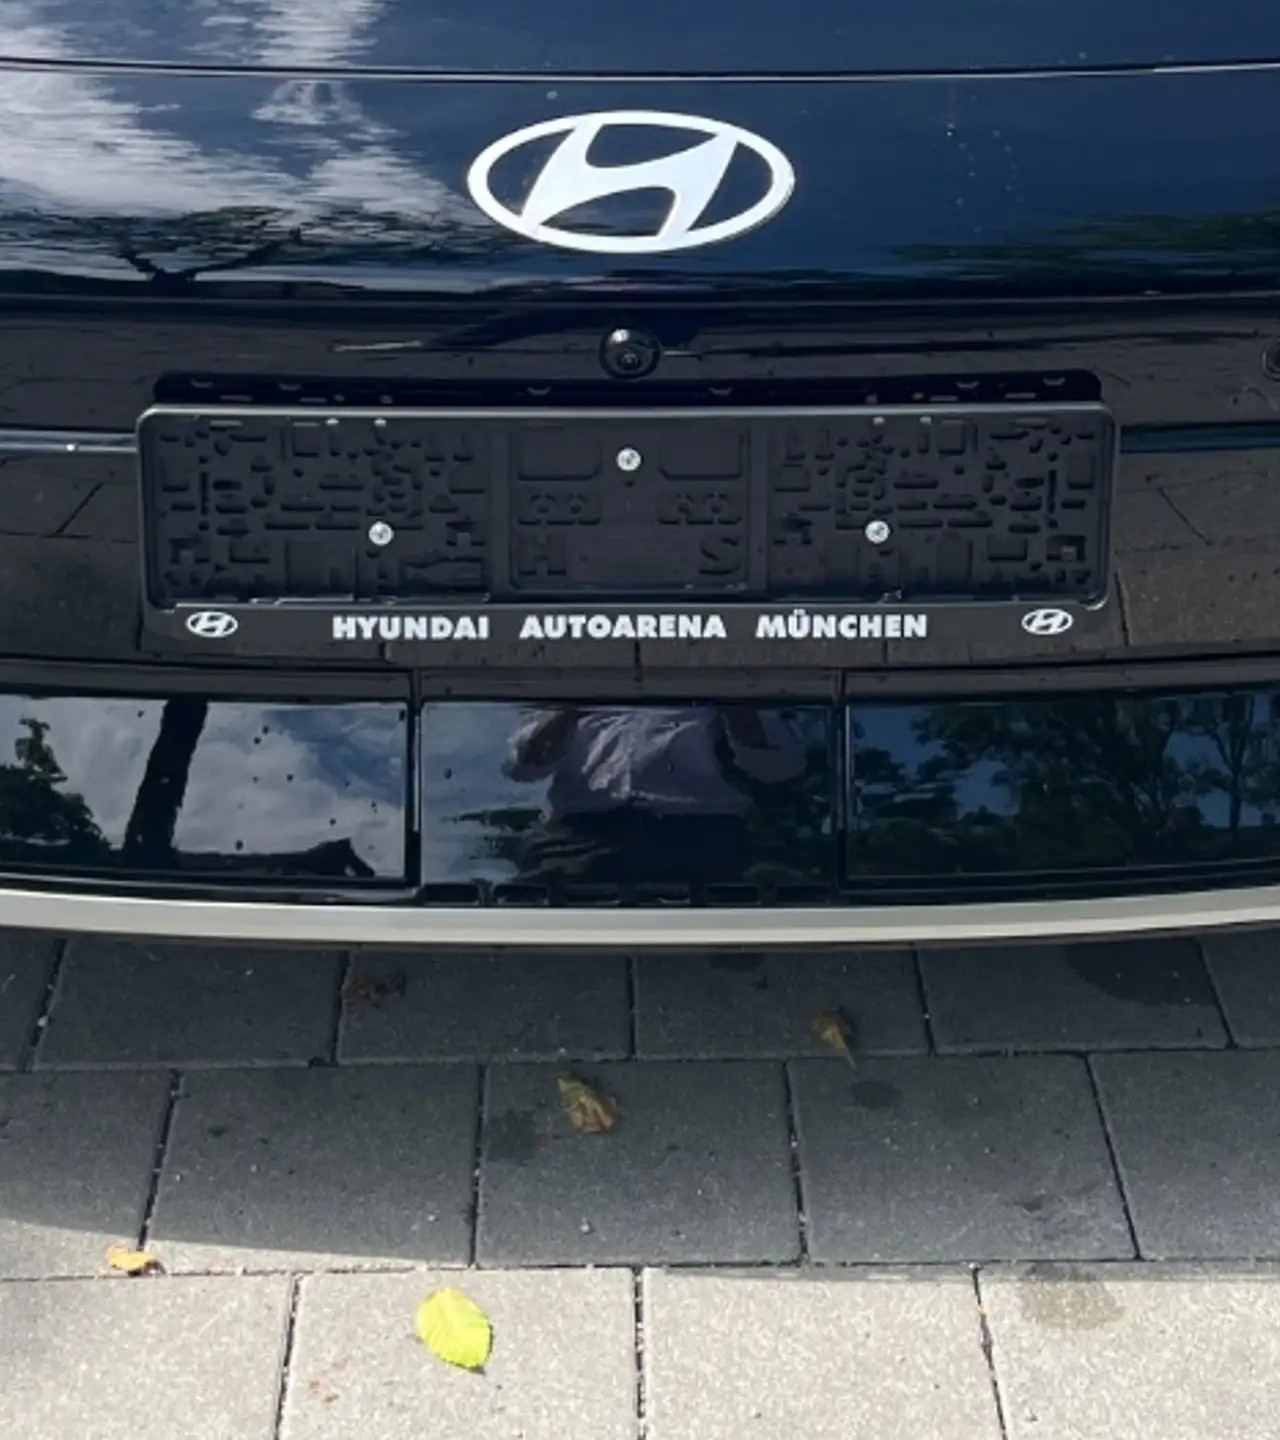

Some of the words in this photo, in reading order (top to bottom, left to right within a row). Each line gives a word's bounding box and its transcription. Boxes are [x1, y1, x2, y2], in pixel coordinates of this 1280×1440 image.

[332, 615, 489, 640] HYUNDAI
[519, 614, 727, 639] AUTOARENA
[755, 609, 927, 639] MÜNCHEN
